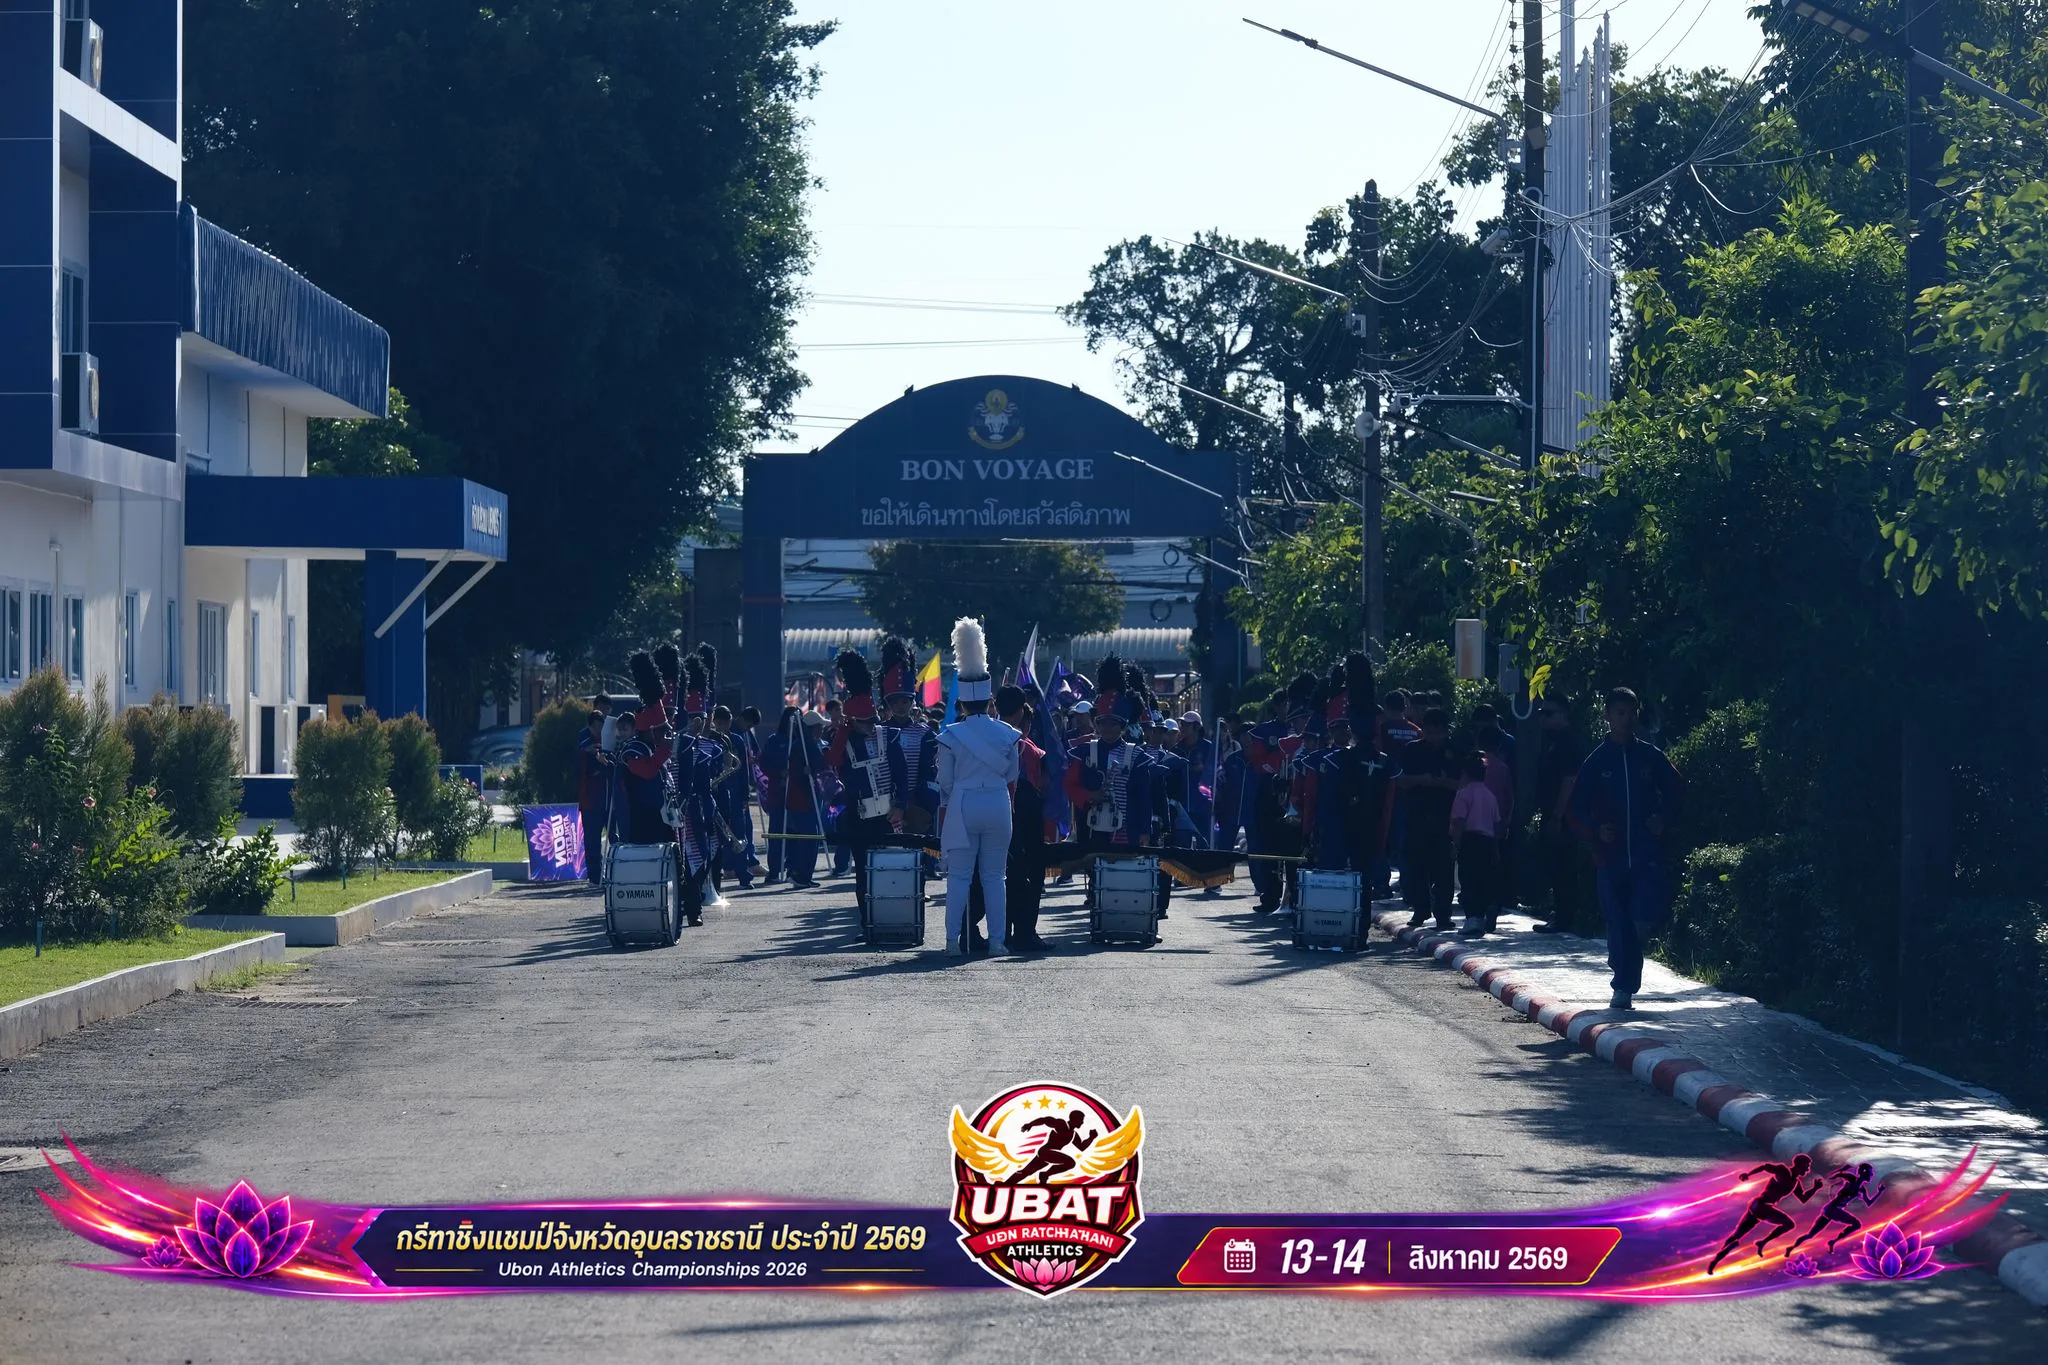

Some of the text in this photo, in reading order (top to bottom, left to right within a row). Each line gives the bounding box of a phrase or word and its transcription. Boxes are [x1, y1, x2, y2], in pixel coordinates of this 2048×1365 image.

[900, 458, 1094, 480] BON VOYAGE
[861, 497, 1131, 526] ขอให้เดินทางโดยสวัสดิภาพ
[625, 889, 655, 899] YAMAHA
